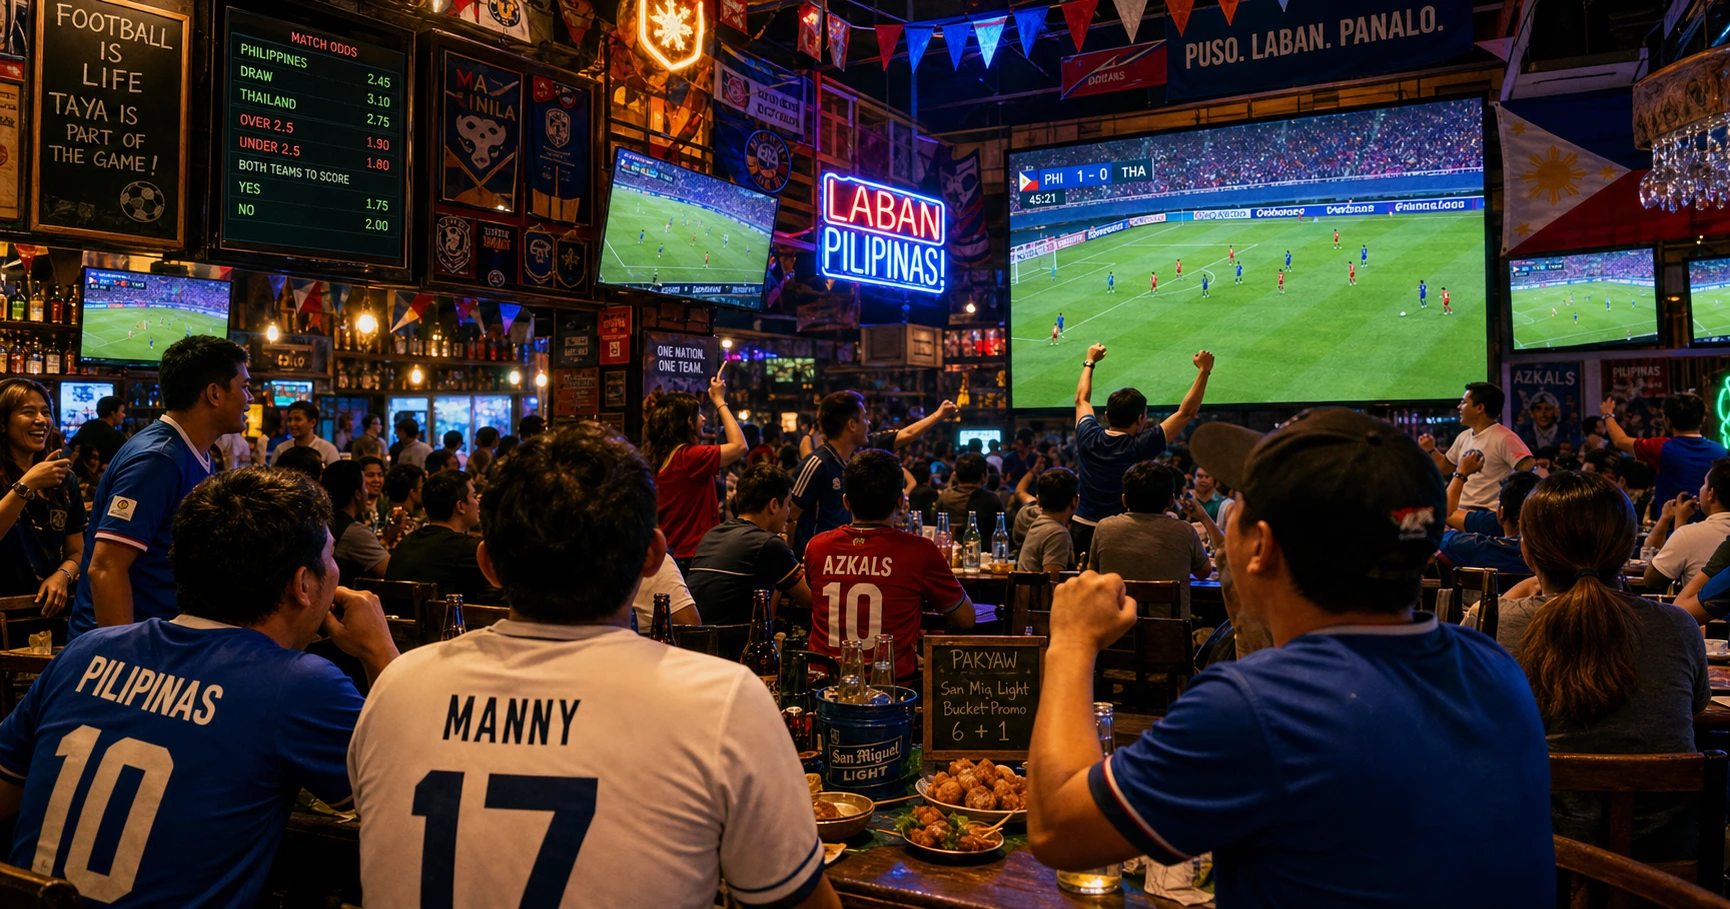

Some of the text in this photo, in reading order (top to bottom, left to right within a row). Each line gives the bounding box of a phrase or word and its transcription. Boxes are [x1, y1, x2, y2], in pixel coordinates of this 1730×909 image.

[57, 3, 173, 49] FOOTBALL
[291, 31, 358, 58] MATCH ODDS
[1186, 5, 1444, 69] PUSO. LABAN. PANALO.
[100, 41, 122, 63] IS
[240, 43, 308, 68] PHILIPPINES
[83, 63, 143, 93] LIFE
[240, 65, 273, 82] DRAW
[367, 73, 391, 88] 2.45
[48, 92, 138, 125] TAYA IS
[240, 88, 297, 110] THAILAND
[367, 93, 390, 107] 3.10
[239, 113, 294, 134] OVER 2.5
[367, 113, 390, 128] 2.75
[67, 124, 146, 149] PART OF
[239, 136, 300, 157] UNDER 2.5
[366, 136, 390, 150] 1.90
[48, 145, 85, 164] THE
[366, 157, 390, 171] 1.80
[238, 159, 350, 185] BOTH TEAMS TO SCORE
[1044, 172, 1063, 185] PHI
[1076, 170, 1083, 183] 1
[1100, 168, 1108, 181] 0
[1122, 165, 1146, 178] THA
[238, 180, 261, 195] YES
[238, 203, 255, 216] NO
[366, 198, 389, 211] 1.75
[829, 178, 940, 241] LABAN
[1029, 193, 1056, 205] 45:21
[365, 218, 389, 232] 2.00
[824, 226, 945, 287] PILIPINAS!
[657, 345, 706, 360] ONE NATION.
[658, 360, 704, 374] ONE TEAM.
[1612, 366, 1660, 378] PILIPINAS
[1513, 370, 1576, 386] AZKALS
[822, 555, 893, 577] AZKALS
[822, 582, 883, 650] 10
[950, 649, 1018, 669] PAKYAW
[75, 655, 224, 726] PILIPINAS
[940, 680, 965, 696] San
[997, 681, 1030, 700] Light
[943, 701, 1027, 717] Bucket Promo
[442, 694, 582, 746] MANNY
[951, 720, 965, 742] 6
[998, 720, 1010, 742] 1
[832, 741, 900, 764] San Miguel
[843, 765, 888, 781] LIGHT
[31, 724, 174, 904] 10
[411, 770, 599, 909] 17
